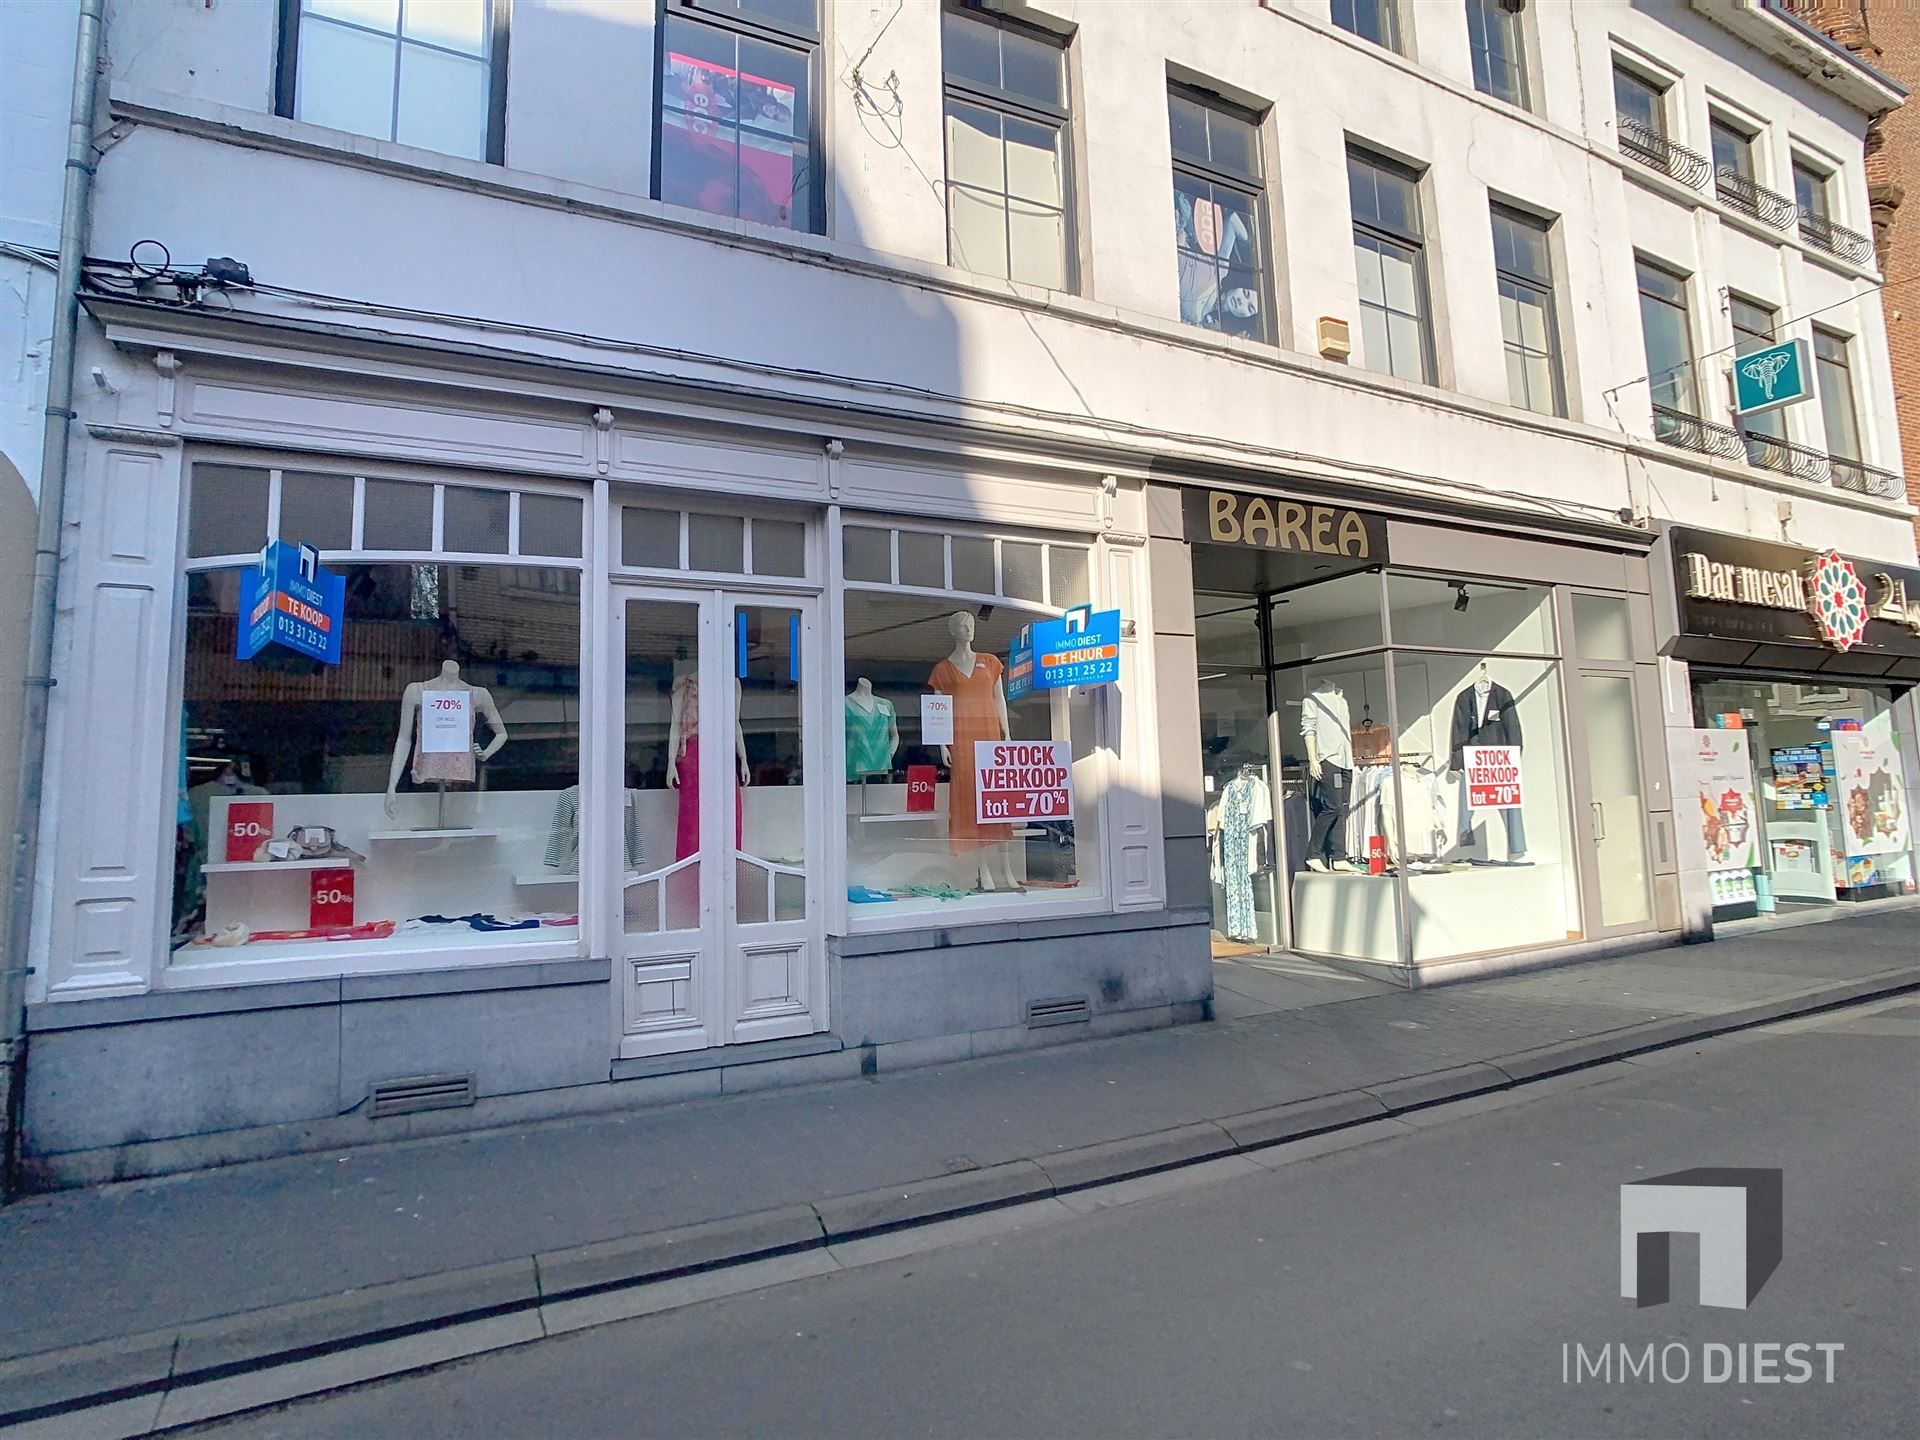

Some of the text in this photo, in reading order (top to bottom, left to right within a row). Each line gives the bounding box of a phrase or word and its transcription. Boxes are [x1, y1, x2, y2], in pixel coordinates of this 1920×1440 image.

[1208, 490, 1369, 559] BAREA
[306, 588, 323, 608] DIEST
[287, 596, 300, 617] TE
[300, 602, 324, 628] KOOP
[278, 615, 295, 636] 013
[296, 623, 306, 641] 31
[307, 629, 318, 646] 25
[318, 634, 328, 650] 22
[1055, 633, 1102, 651] IMMO DIEST
[1053, 647, 1104, 666] TE HUUR
[1045, 669, 1064, 681] 013
[1067, 666, 1079, 678] 31
[1083, 663, 1096, 676] 25
[1099, 661, 1113, 674] 22
[430, 699, 462, 710] -70%
[926, 701, 948, 711] -70%
[993, 745, 1055, 767] STOCK
[1475, 749, 1511, 766] STOCK
[980, 767, 1068, 789] VERKOOP
[1468, 766, 1519, 784] VERKOOP
[985, 790, 1066, 817] tot -70%
[1471, 784, 1520, 805] tot -70%
[229, 822, 272, 837] -50%
[311, 889, 353, 905] -50%
